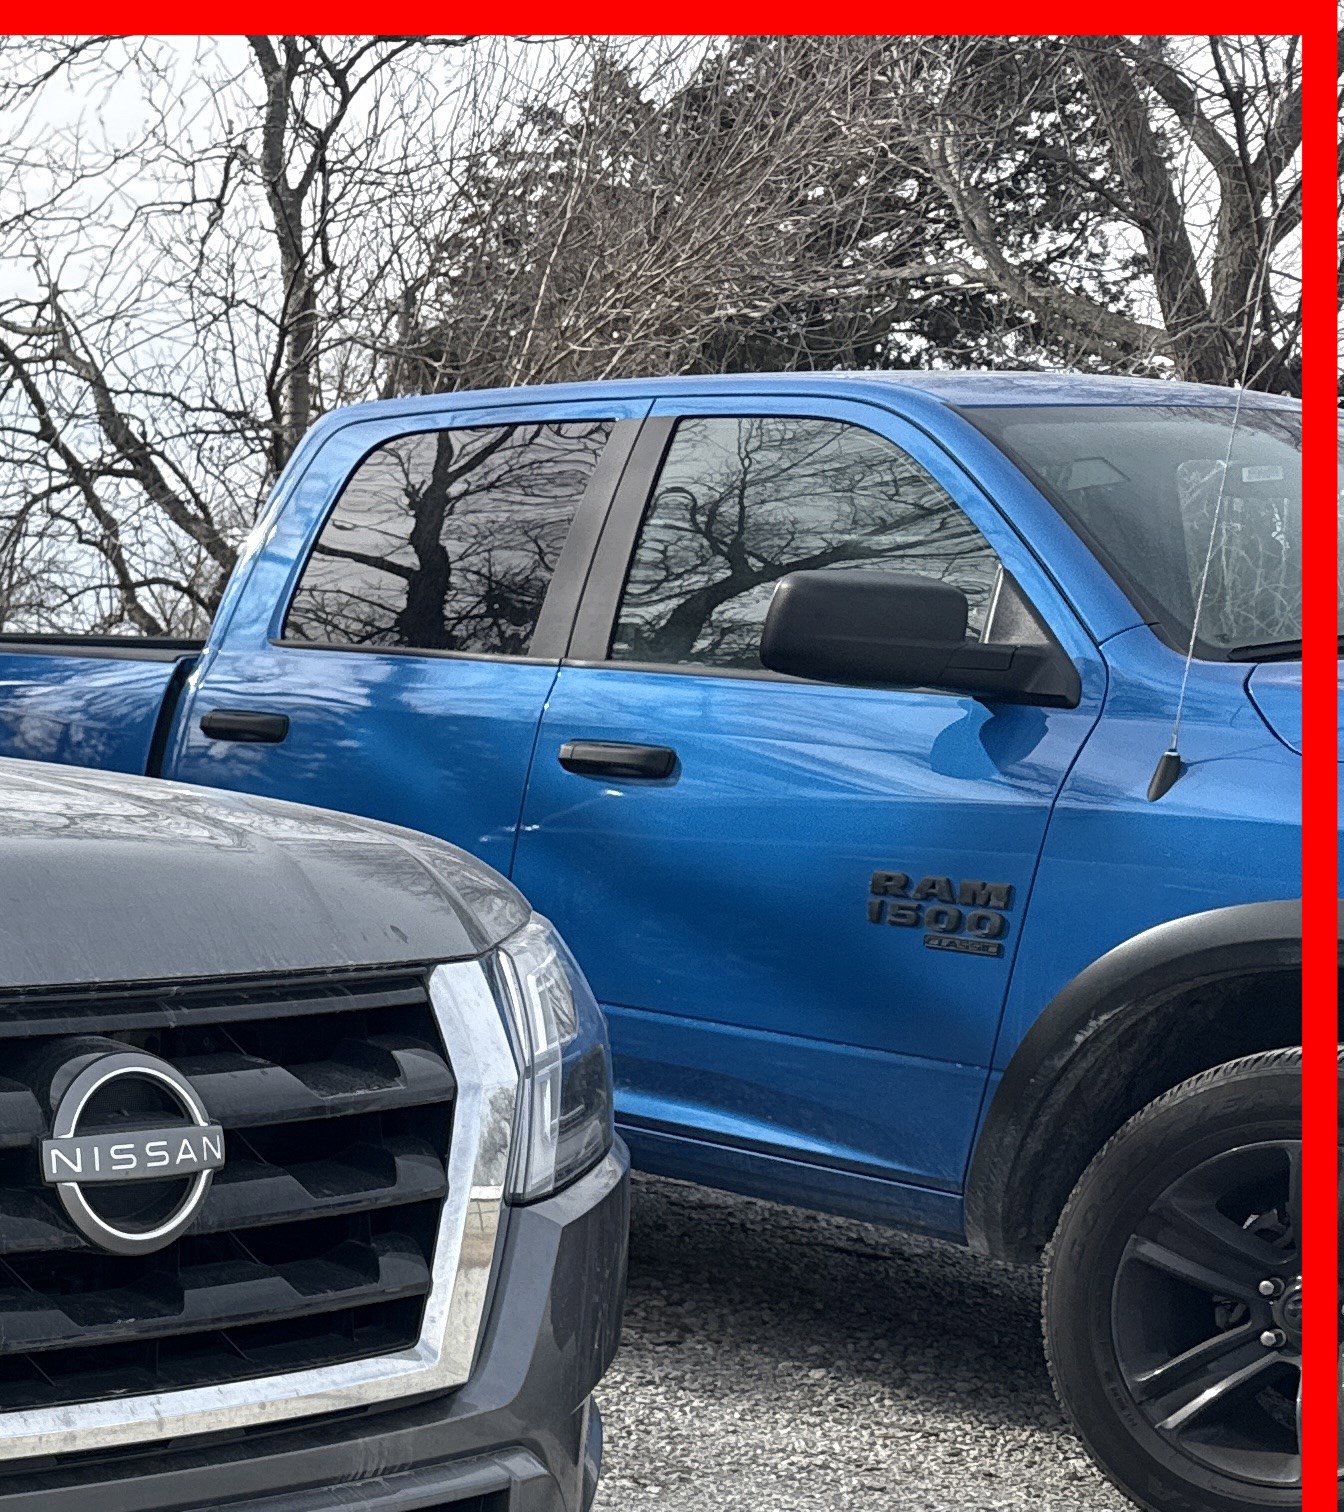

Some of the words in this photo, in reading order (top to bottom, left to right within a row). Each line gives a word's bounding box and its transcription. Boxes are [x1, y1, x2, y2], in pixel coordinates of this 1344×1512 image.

[870, 870, 1015, 911] RAM
[867, 899, 1008, 939] 1500
[50, 1134, 222, 1175] NISSAN
